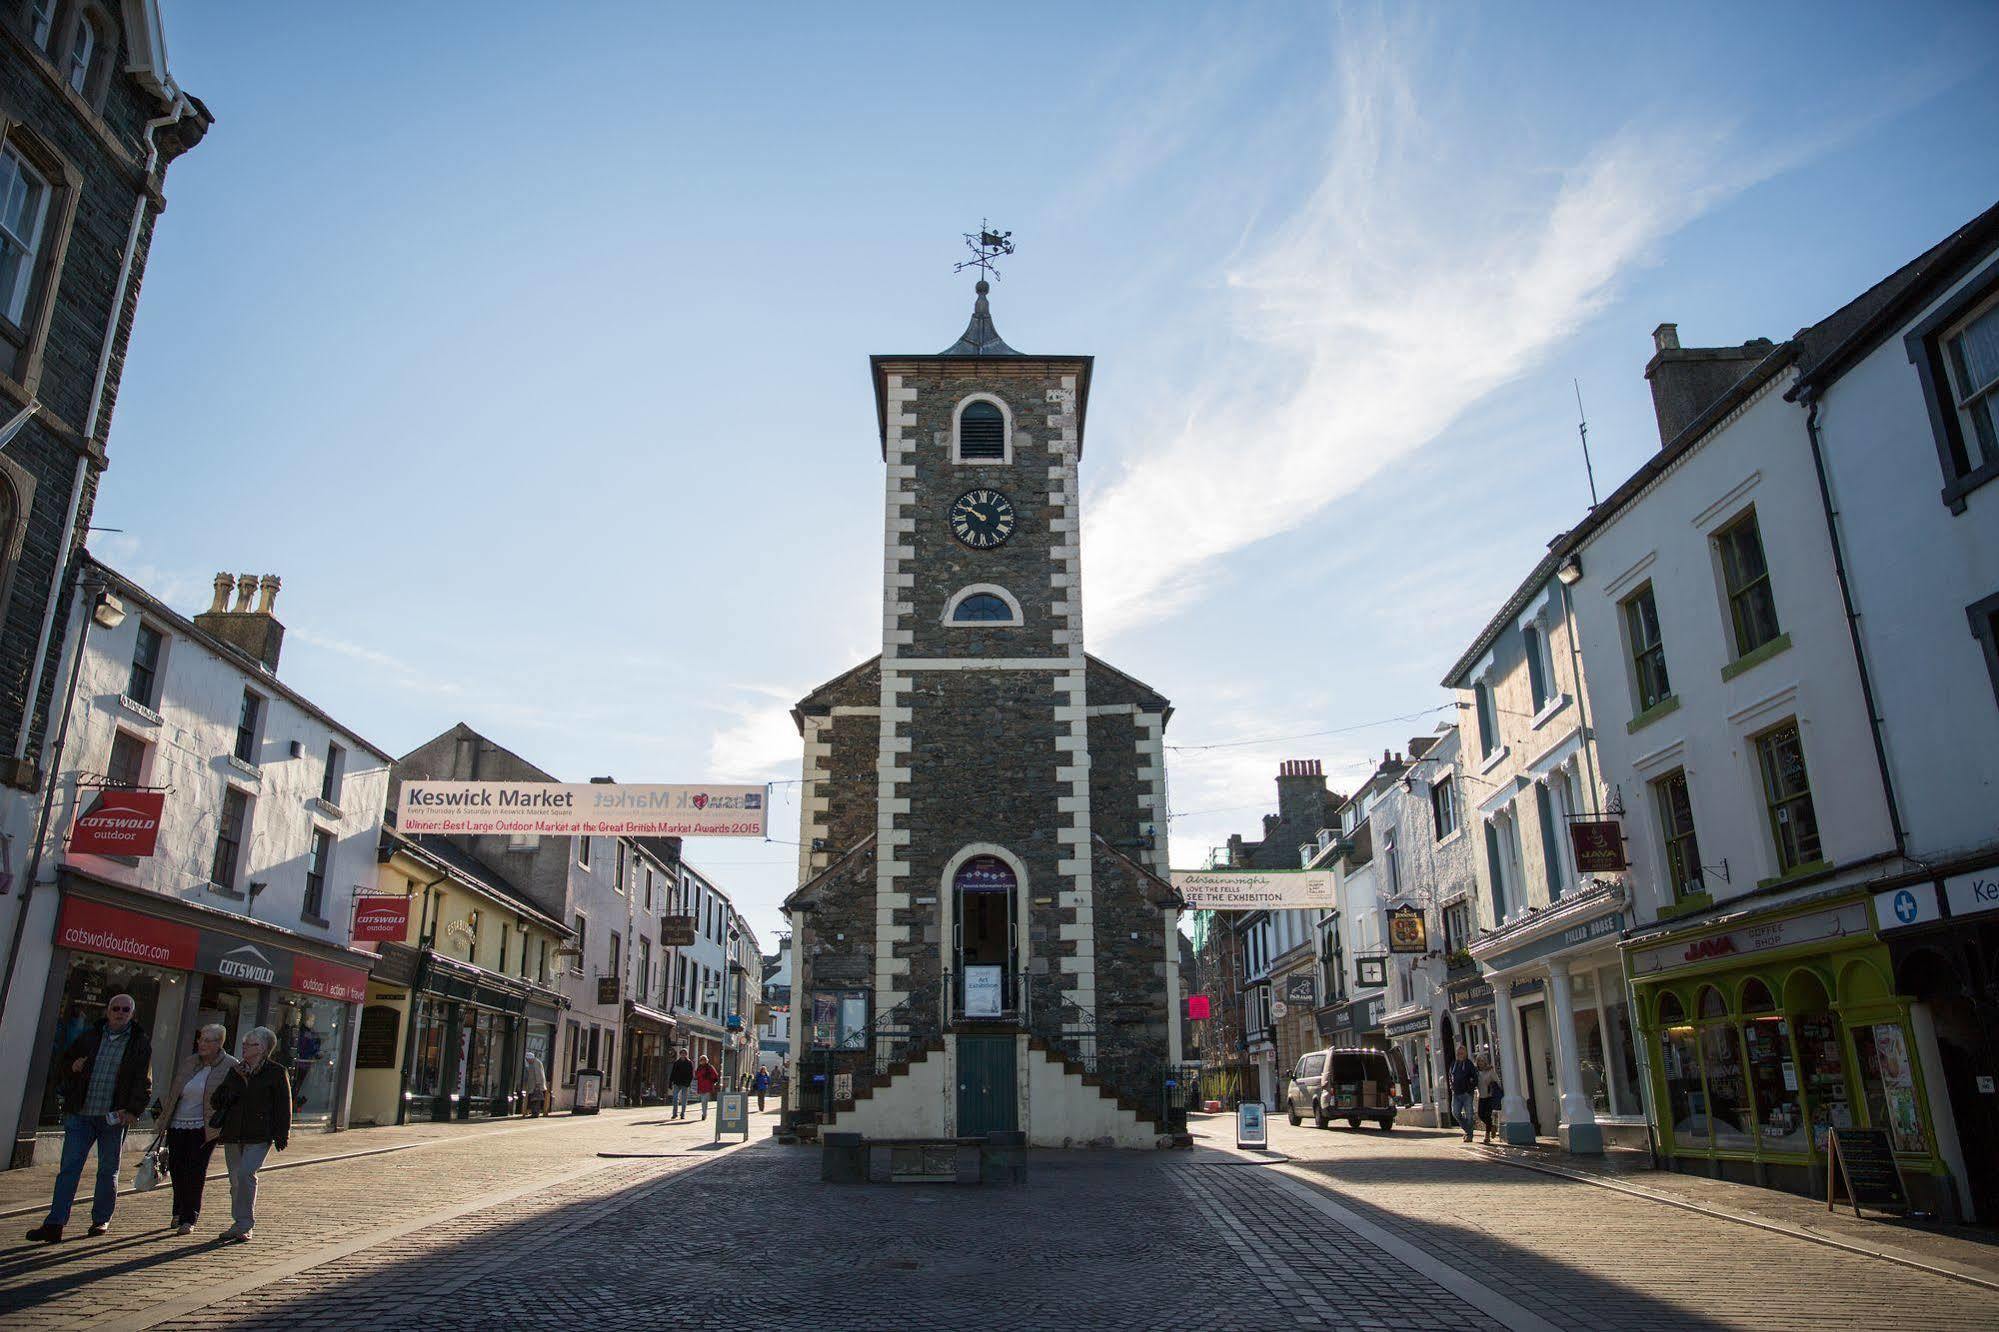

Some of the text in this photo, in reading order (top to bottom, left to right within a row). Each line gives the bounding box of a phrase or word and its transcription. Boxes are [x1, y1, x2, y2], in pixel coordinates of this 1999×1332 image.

[409, 788, 573, 807] Keswick Market
[408, 808, 426, 816] Every
[427, 808, 455, 816] Thursday
[463, 808, 492, 816] Saturday
[493, 808, 499, 816] in
[500, 808, 526, 816] Keswick
[526, 808, 550, 816] Market
[551, 808, 573, 817] Square
[80, 816, 155, 829] COTSWOLD
[406, 819, 760, 833] Winner: Best Large Outdoor Market at the Great British Market Awards 2015
[94, 830, 137, 840] outdoor
[1186, 893, 1282, 901] SEE THE EXHIBITION
[1973, 880, 1999, 903] Ke
[1749, 924, 1784, 938] COFFEE
[65, 928, 170, 960] cotswoldoutdoor.com
[1684, 935, 1737, 961] JAVA
[1755, 937, 1781, 948] SHOP
[219, 959, 274, 983] COTSWOLD
[303, 978, 324, 992] outdoor
[330, 985, 345, 997] action
